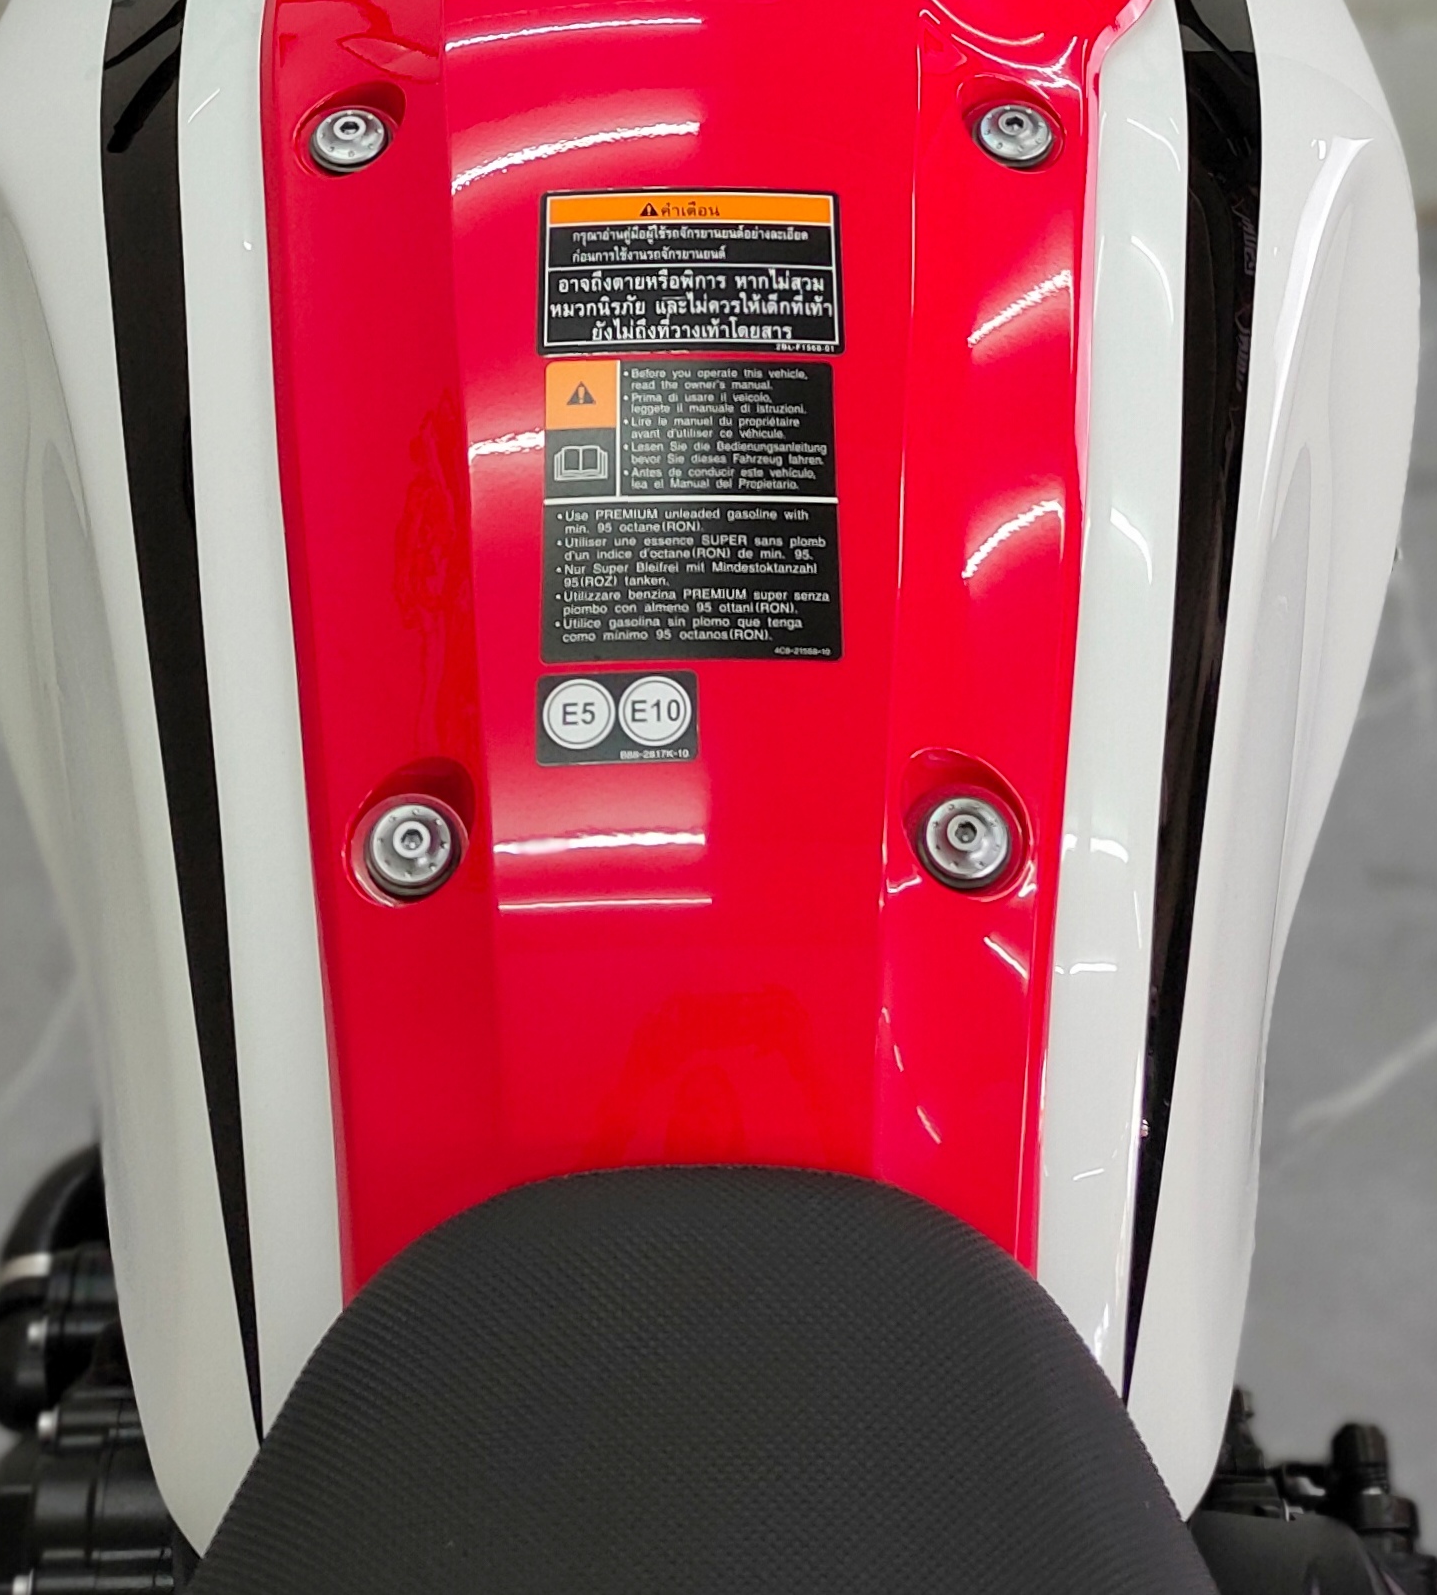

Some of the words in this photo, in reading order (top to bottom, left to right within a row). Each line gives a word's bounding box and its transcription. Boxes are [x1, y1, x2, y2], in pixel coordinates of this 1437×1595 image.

[549, 294, 645, 318] หมวกนิรภัย
[631, 368, 666, 378] Before
[672, 370, 691, 380] you
[697, 368, 737, 379] operate
[744, 368, 763, 378] this
[631, 380, 655, 389] read
[662, 381, 678, 389] the
[684, 380, 725, 389] owner's
[731, 380, 773, 390] manual.
[631, 393, 662, 402] Prima
[668, 393, 678, 402] di
[685, 393, 714, 402] usare
[721, 392, 726, 402] il
[631, 403, 670, 415] leggete
[677, 403, 683, 413] il
[689, 404, 734, 413] manuale
[740, 404, 750, 413] di
[757, 404, 807, 414] istruzioni.
[632, 416, 651, 426] Lire
[658, 416, 667, 426] le
[674, 416, 713, 426] manuel
[719, 416, 732, 426] du
[631, 429, 660, 439] avant
[667, 428, 713, 438] d'utiliser
[720, 430, 733, 438] ce
[631, 442, 663, 452] Lesen
[670, 441, 687, 451] Sie
[694, 442, 710, 451] die
[717, 441, 827, 455] Bedienungsanleitung
[631, 454, 661, 464] bevor
[667, 453, 684, 464] Sie
[733, 454, 782, 466] Fahrzeug
[631, 467, 662, 477] Antes
[669, 468, 682, 477] de
[688, 467, 735, 477] conducir
[741, 468, 763, 477] este
[632, 478, 647, 489] lea
[654, 479, 664, 489] el
[670, 478, 709, 489] Manual
[716, 478, 732, 489] del
[565, 510, 588, 522] Use
[596, 509, 658, 520] PREMIUM
[665, 508, 720, 520] unleaded
[727, 508, 777, 521] gasoline
[784, 509, 809, 520] with
[565, 524, 589, 534] min.
[597, 523, 612, 533] 95
[565, 537, 607, 548] Utiliser
[614, 537, 636, 546] une
[644, 537, 694, 546] essence
[702, 534, 747, 546] SUPER
[754, 537, 783, 546] sans
[790, 536, 826, 549] plomb
[565, 551, 589, 561] d'un
[597, 549, 632, 559] indice
[737, 548, 753, 559] de
[760, 548, 786, 559] min.
[564, 564, 586, 575] Nur
[592, 563, 628, 574] Super
[636, 562, 679, 573] Bleifrei
[686, 561, 705, 573] mit
[712, 561, 817, 574] Mindestoktanzahl
[564, 590, 621, 602] Utilizzare
[628, 589, 676, 600] benzina
[683, 588, 746, 600] PREMIUM
[754, 590, 788, 601] super
[794, 592, 830, 602] senza
[563, 604, 608, 617] piombo
[615, 604, 637, 613] con
[645, 601, 689, 613] almeno
[696, 602, 712, 613] 95
[563, 618, 601, 629] Utilice
[609, 616, 660, 630] gasolina
[668, 616, 686, 627] sin
[693, 616, 730, 629] plomo
[737, 618, 760, 629] que
[768, 617, 803, 631] tenga
[562, 633, 596, 642] como
[656, 629, 672, 640] 95
[561, 701, 596, 726] E5
[631, 698, 681, 723] E10
